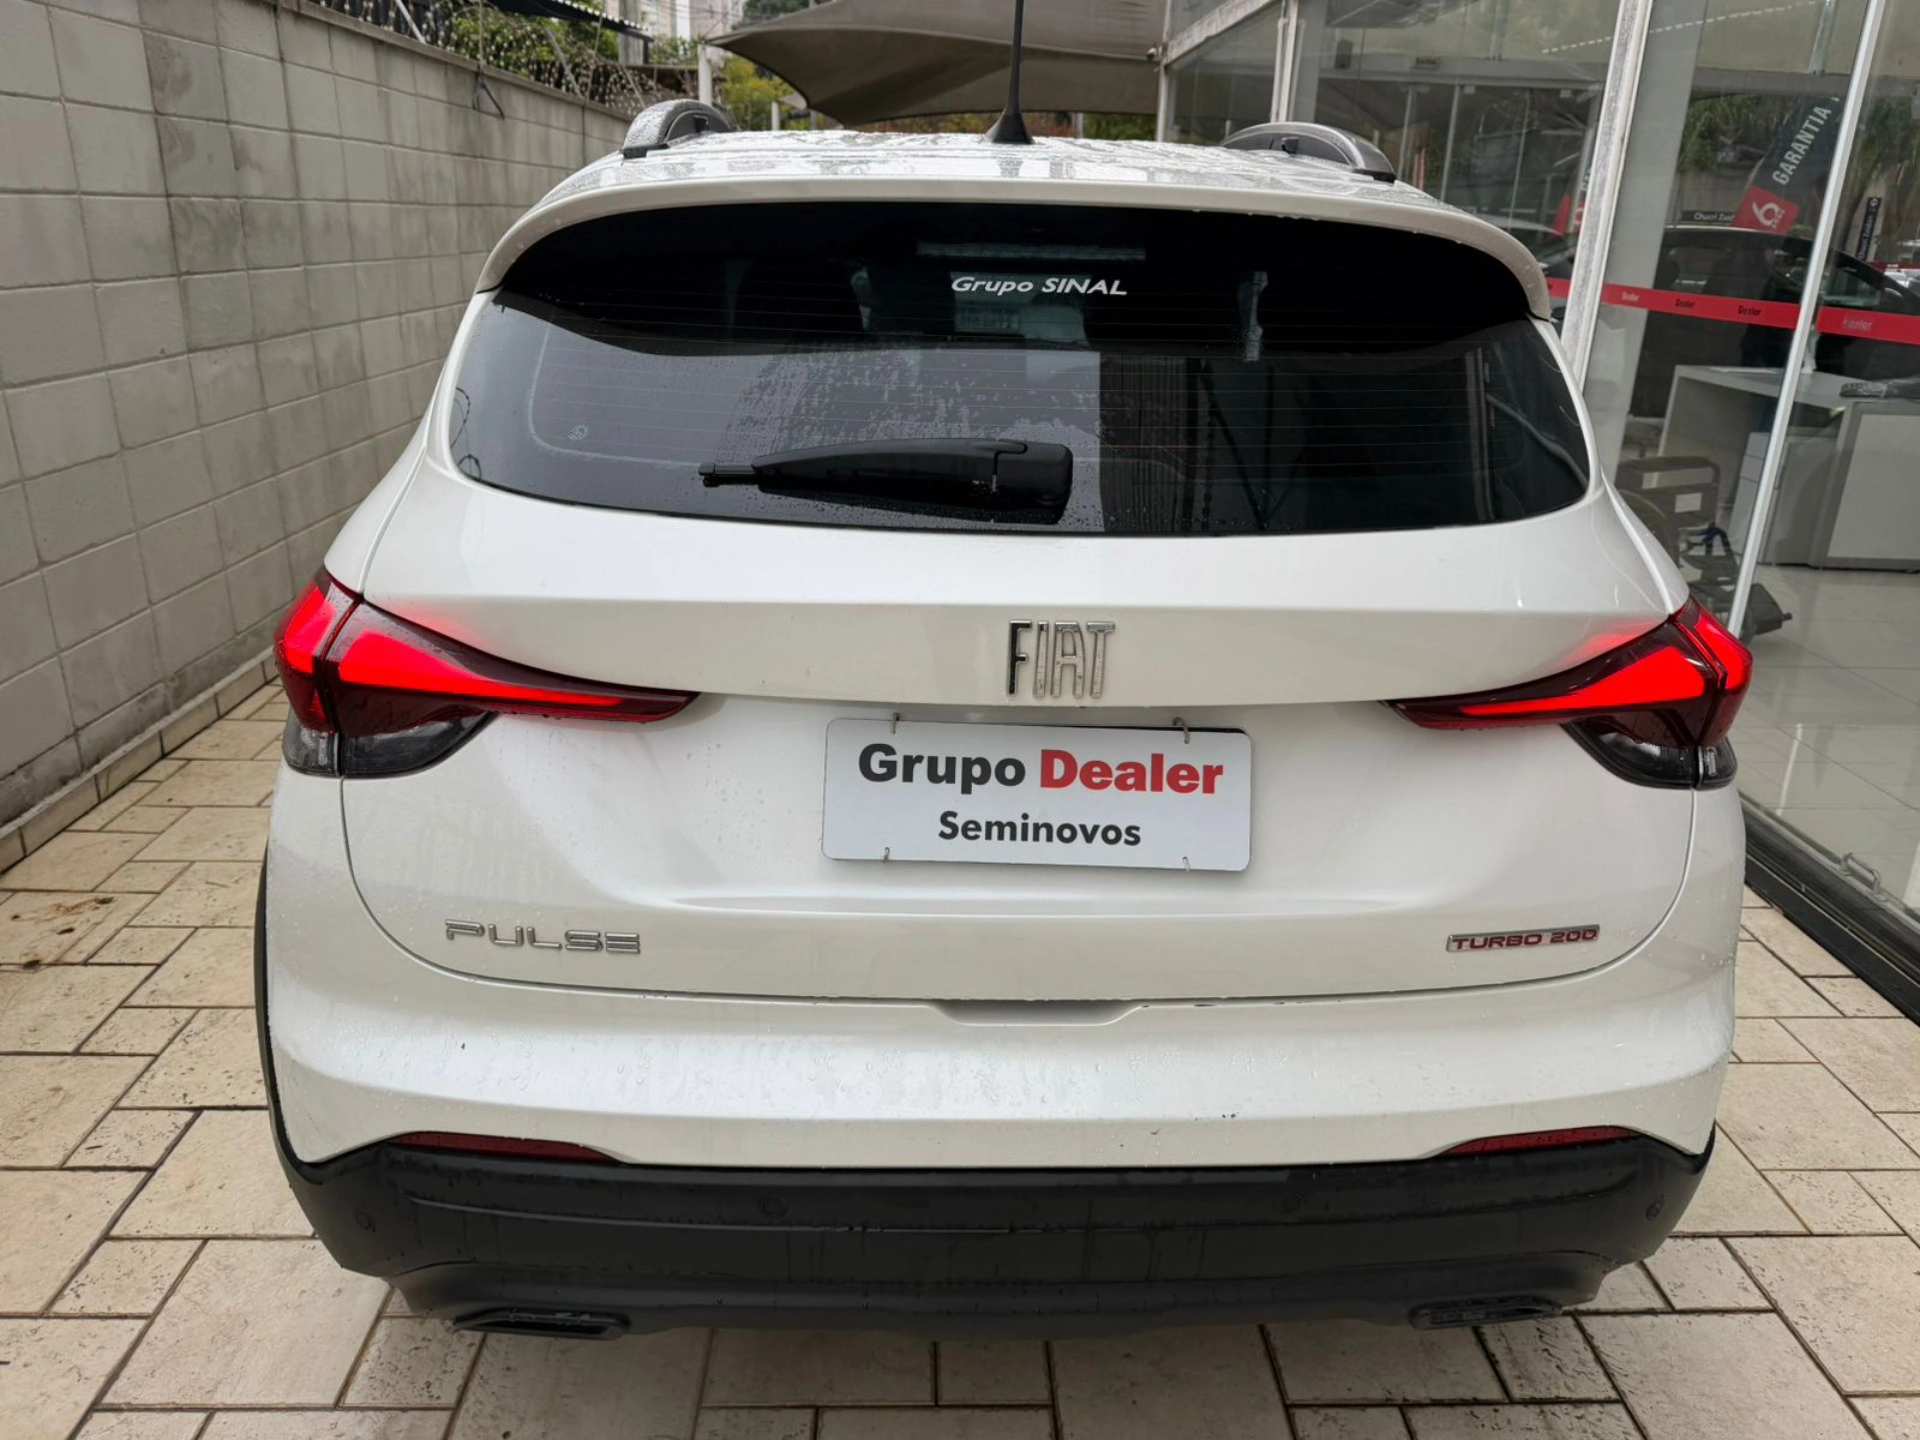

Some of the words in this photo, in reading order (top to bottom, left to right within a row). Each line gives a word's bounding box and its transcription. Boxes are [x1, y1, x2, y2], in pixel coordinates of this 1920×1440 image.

[1772, 106, 1832, 185] GARANTIA
[951, 276, 1034, 296] Grupo
[1041, 277, 1128, 296] SINAL
[1006, 618, 1116, 699] FIAT
[858, 743, 1026, 795] Grupo
[1040, 749, 1224, 795] Dealer
[938, 810, 1142, 846] Seminovos
[444, 918, 641, 954] PULSE
[1451, 933, 1543, 950] TURBO
[1550, 928, 1599, 944] 200
